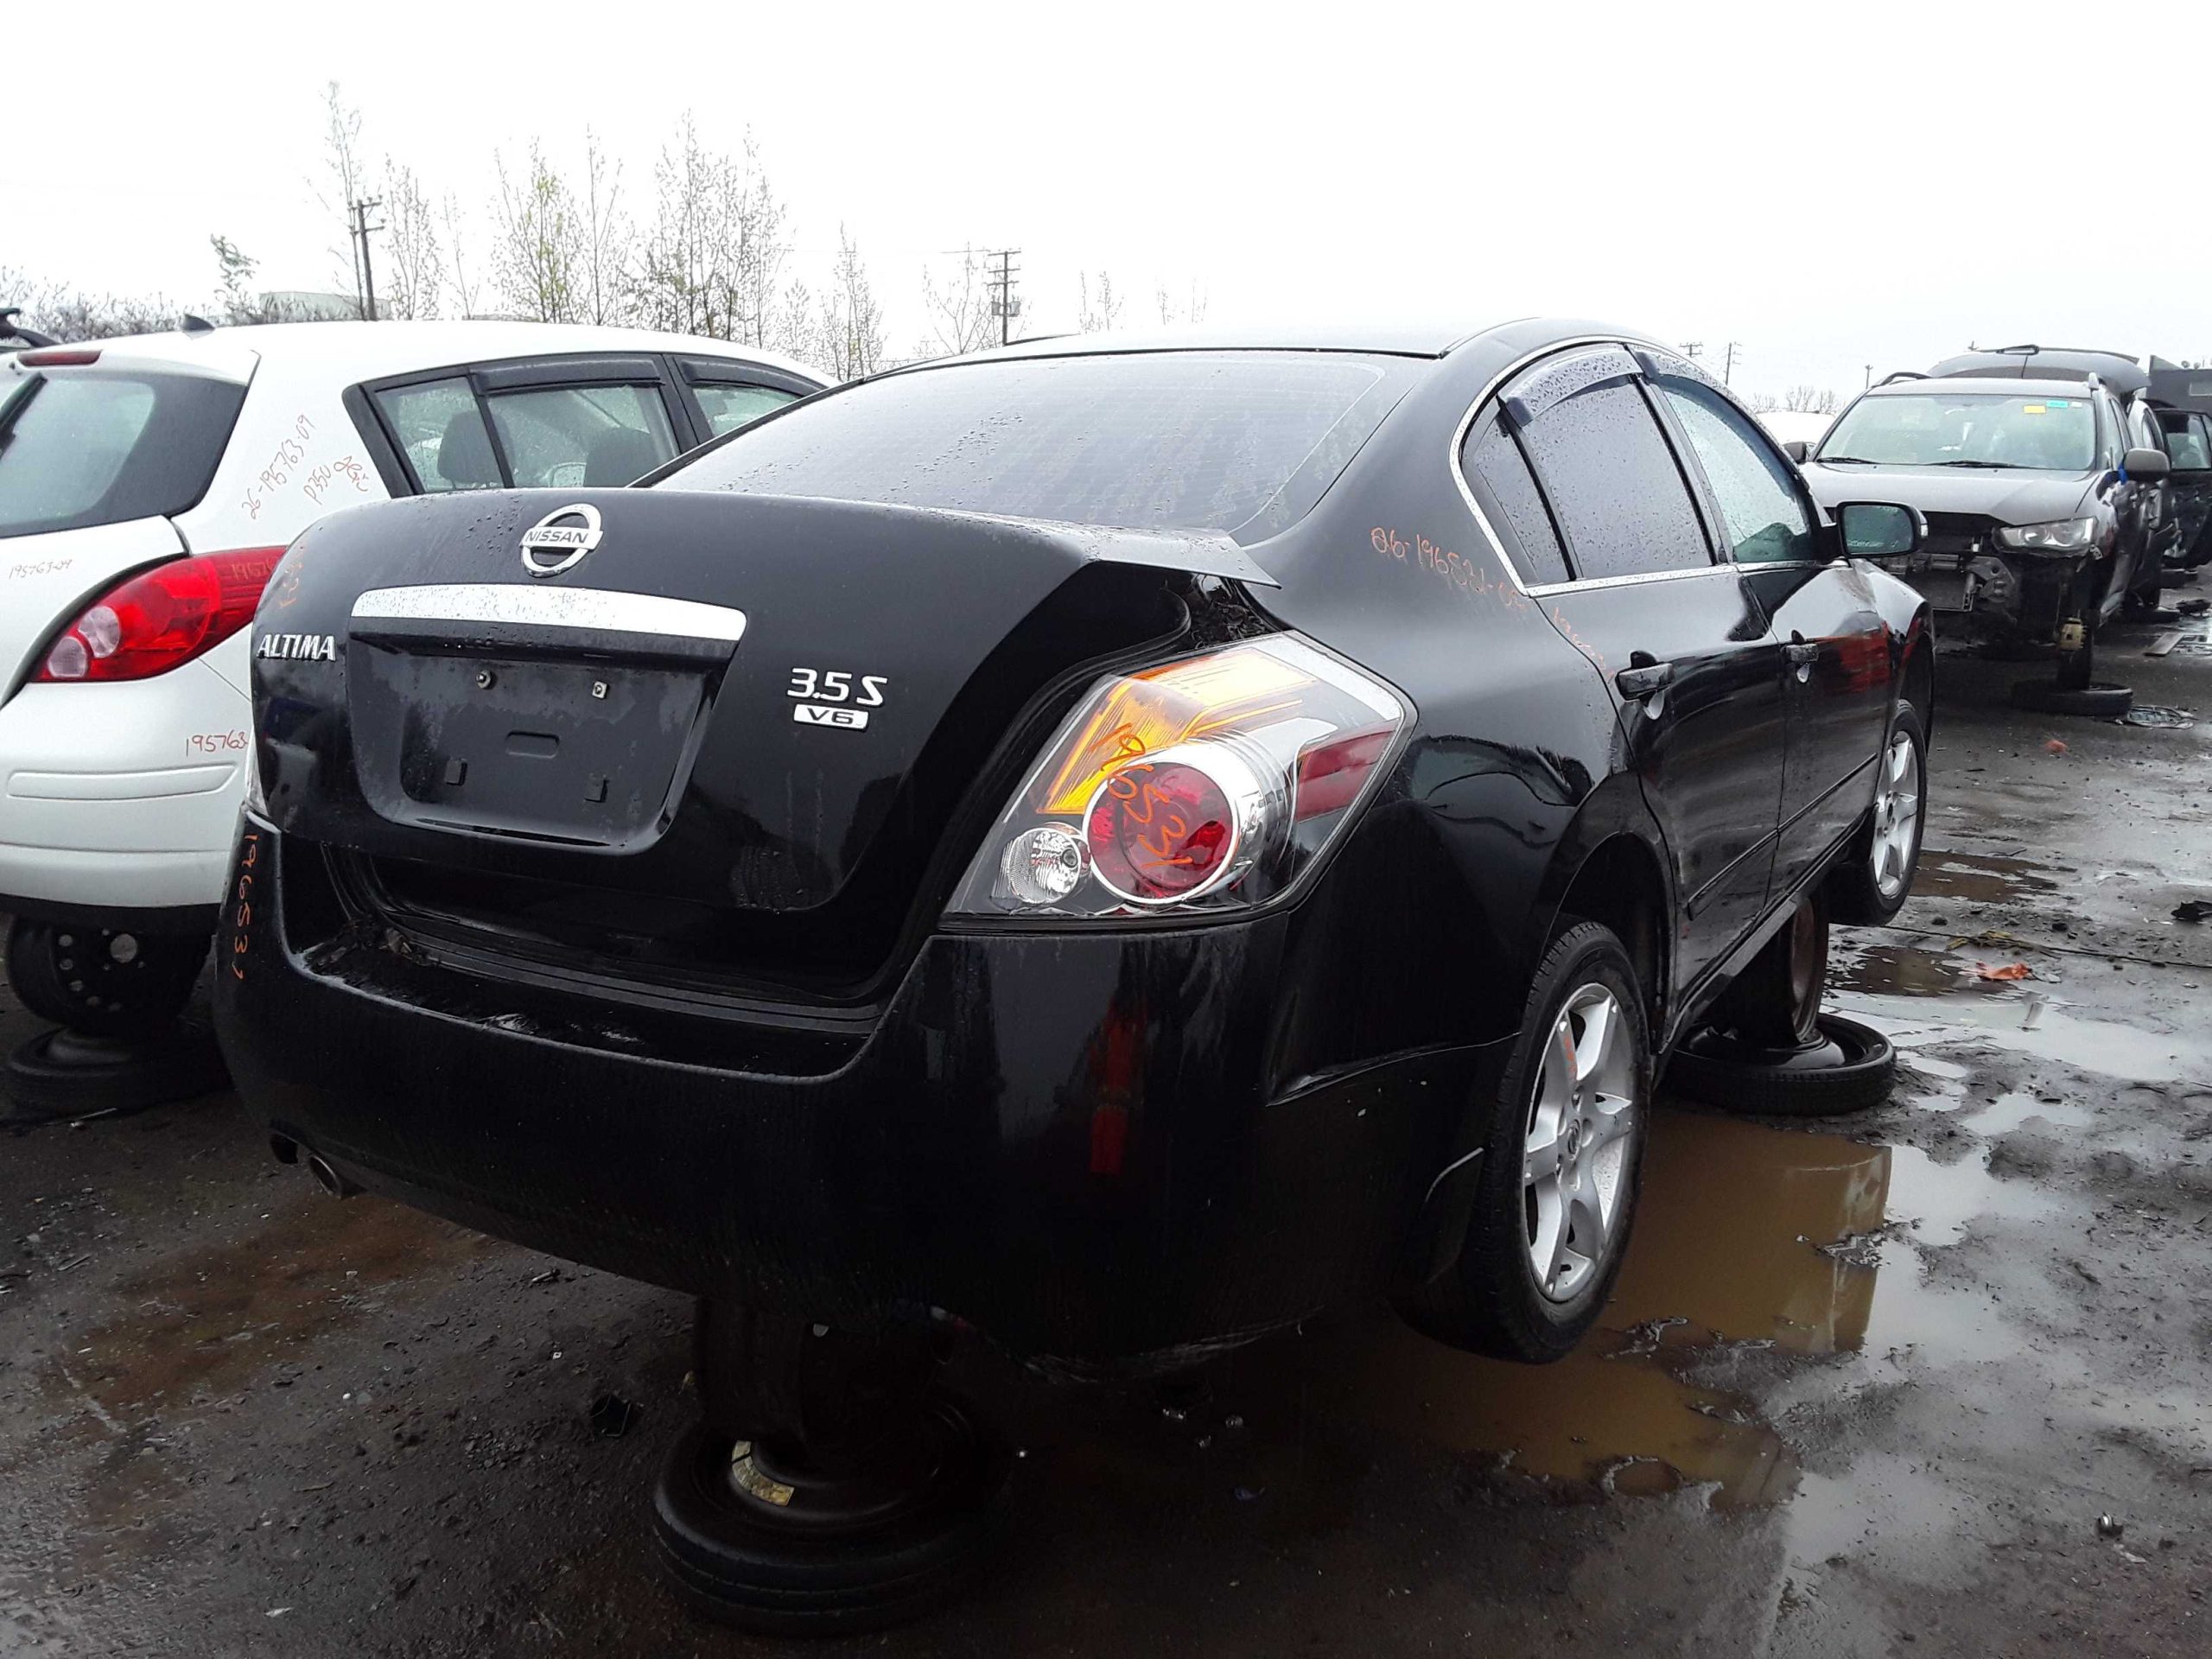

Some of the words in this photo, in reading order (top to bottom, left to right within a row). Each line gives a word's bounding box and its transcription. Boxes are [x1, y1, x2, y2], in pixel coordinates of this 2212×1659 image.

[524, 529, 588, 544] NISSAN
[256, 633, 337, 662] ALTIMA
[787, 667, 853, 702] 3.5
[855, 675, 888, 706] S
[807, 707, 855, 725] V6
[186, 729, 249, 757] 195763
[1089, 721, 1193, 869] 196531
[232, 834, 260, 980] 196531
